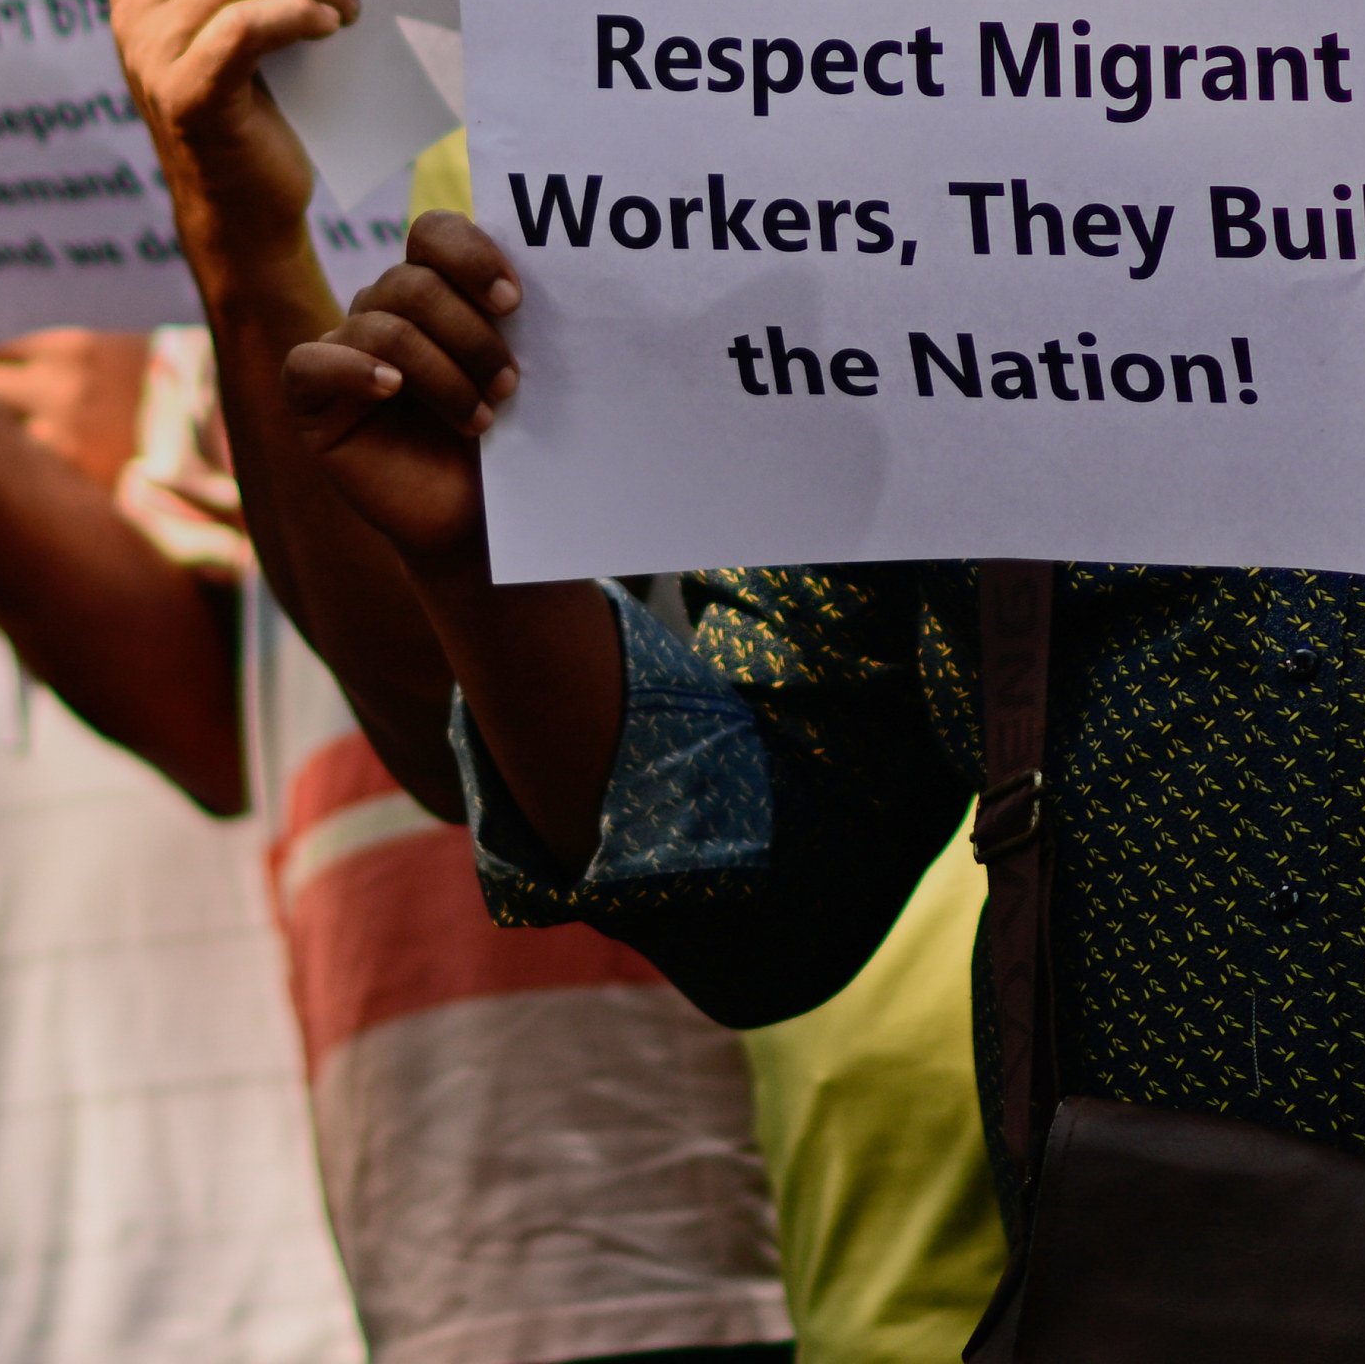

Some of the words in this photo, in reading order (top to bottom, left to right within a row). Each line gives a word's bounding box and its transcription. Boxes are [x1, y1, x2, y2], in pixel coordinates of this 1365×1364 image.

[596, 14, 944, 116] Respect
[980, 19, 1353, 124] Migrant
[66, 236, 122, 267] we
[508, 172, 917, 267] Workers,
[949, 177, 1176, 280] They
[728, 326, 878, 396] the
[909, 330, 1258, 406] Nation!
